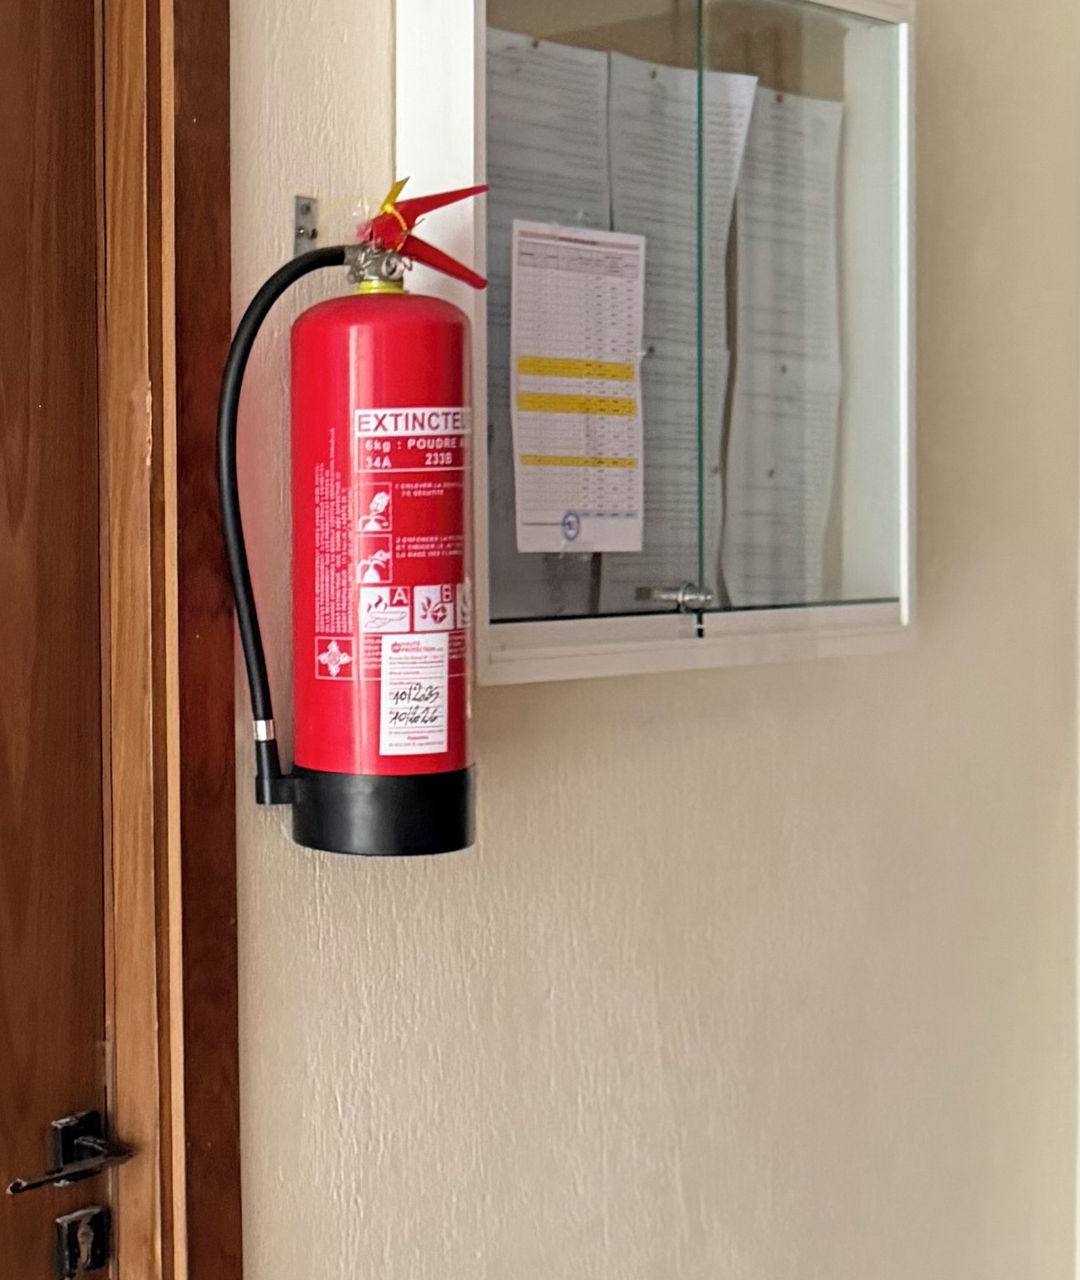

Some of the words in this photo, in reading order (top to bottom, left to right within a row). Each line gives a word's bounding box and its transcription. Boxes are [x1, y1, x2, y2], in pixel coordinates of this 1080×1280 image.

[358, 411, 467, 432] EXTINCTE
[365, 439, 391, 453] 6kg
[407, 437, 457, 450] POUDRE
[365, 455, 392, 469] 34A
[425, 452, 453, 466] 233B
[392, 588, 409, 604] A
[442, 586, 452, 601] B
